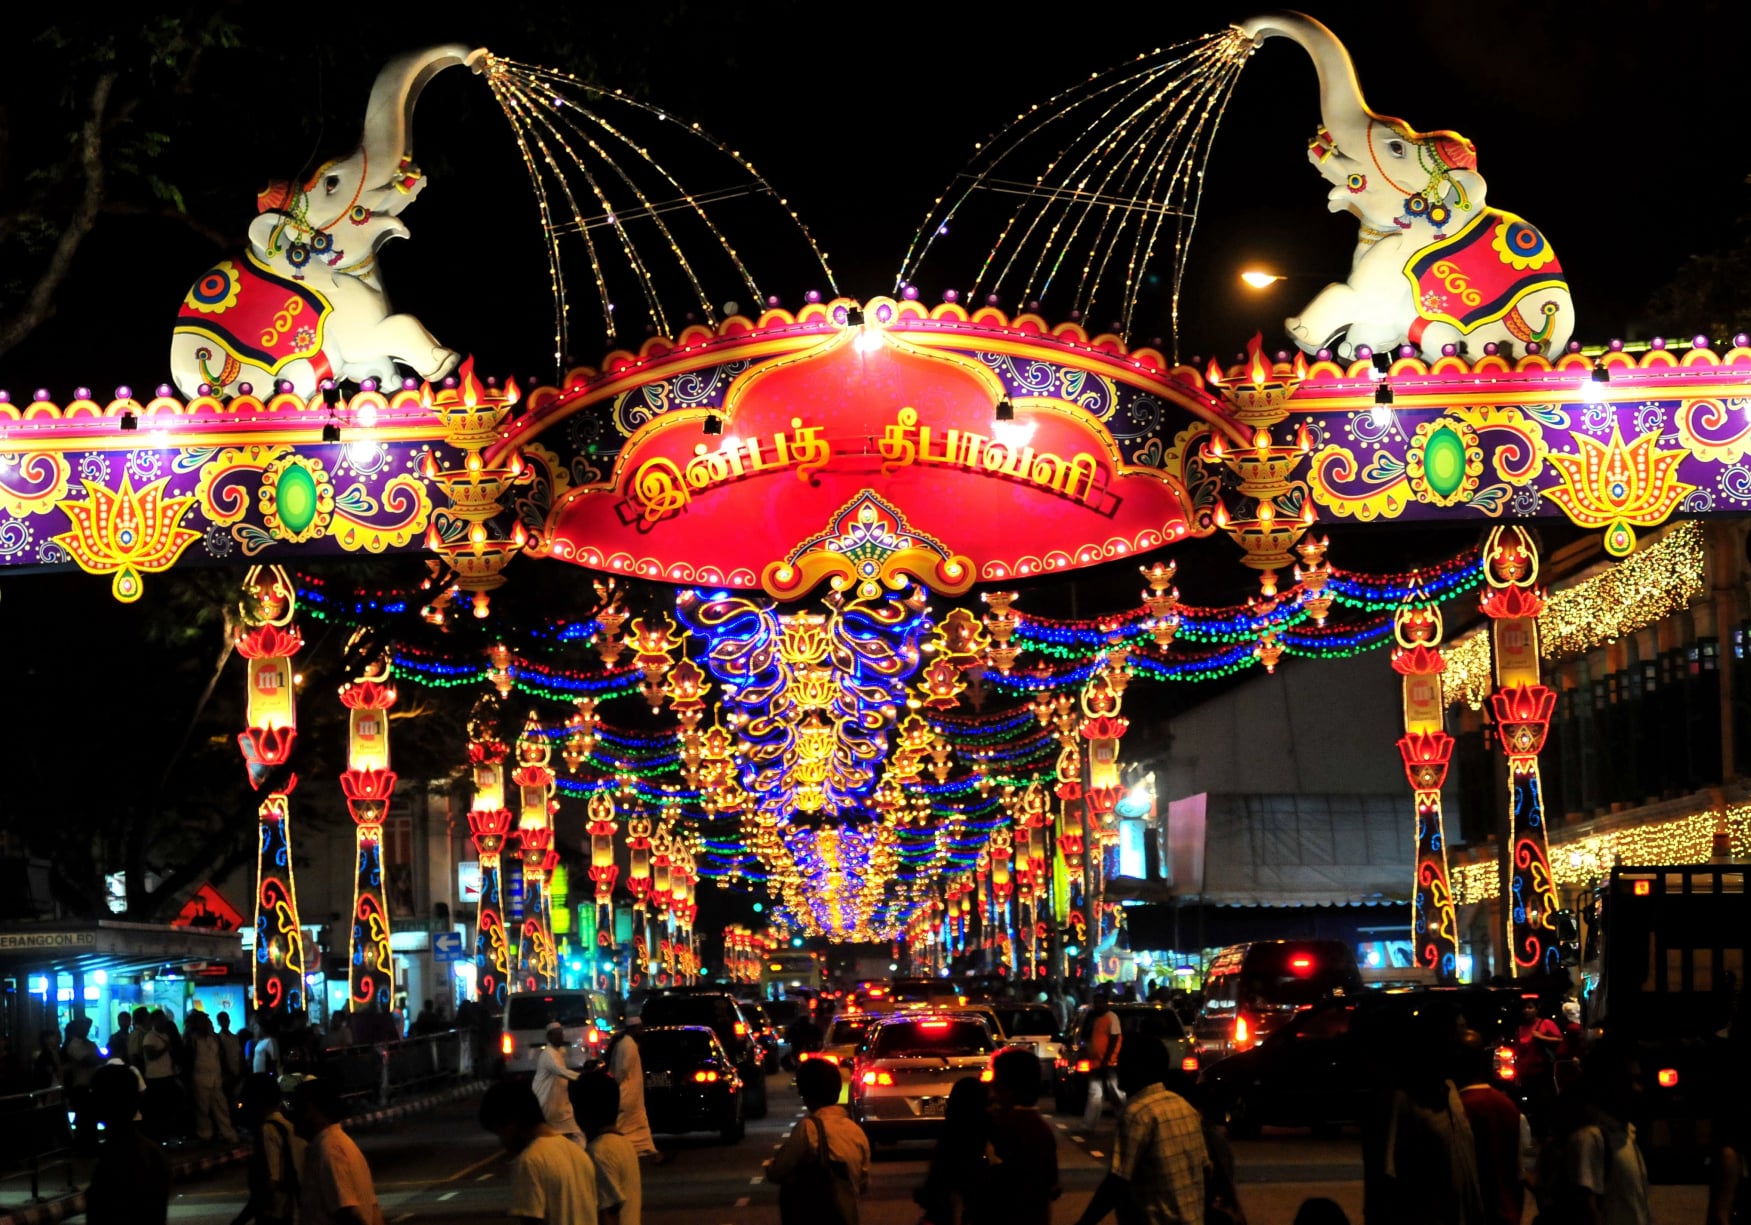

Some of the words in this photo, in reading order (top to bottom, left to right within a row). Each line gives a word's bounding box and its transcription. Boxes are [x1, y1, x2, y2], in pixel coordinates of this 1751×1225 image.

[635, 418, 830, 522] இன்பத்
[879, 406, 1095, 502] தீபாவளி
[77, 934, 94, 944] RD
